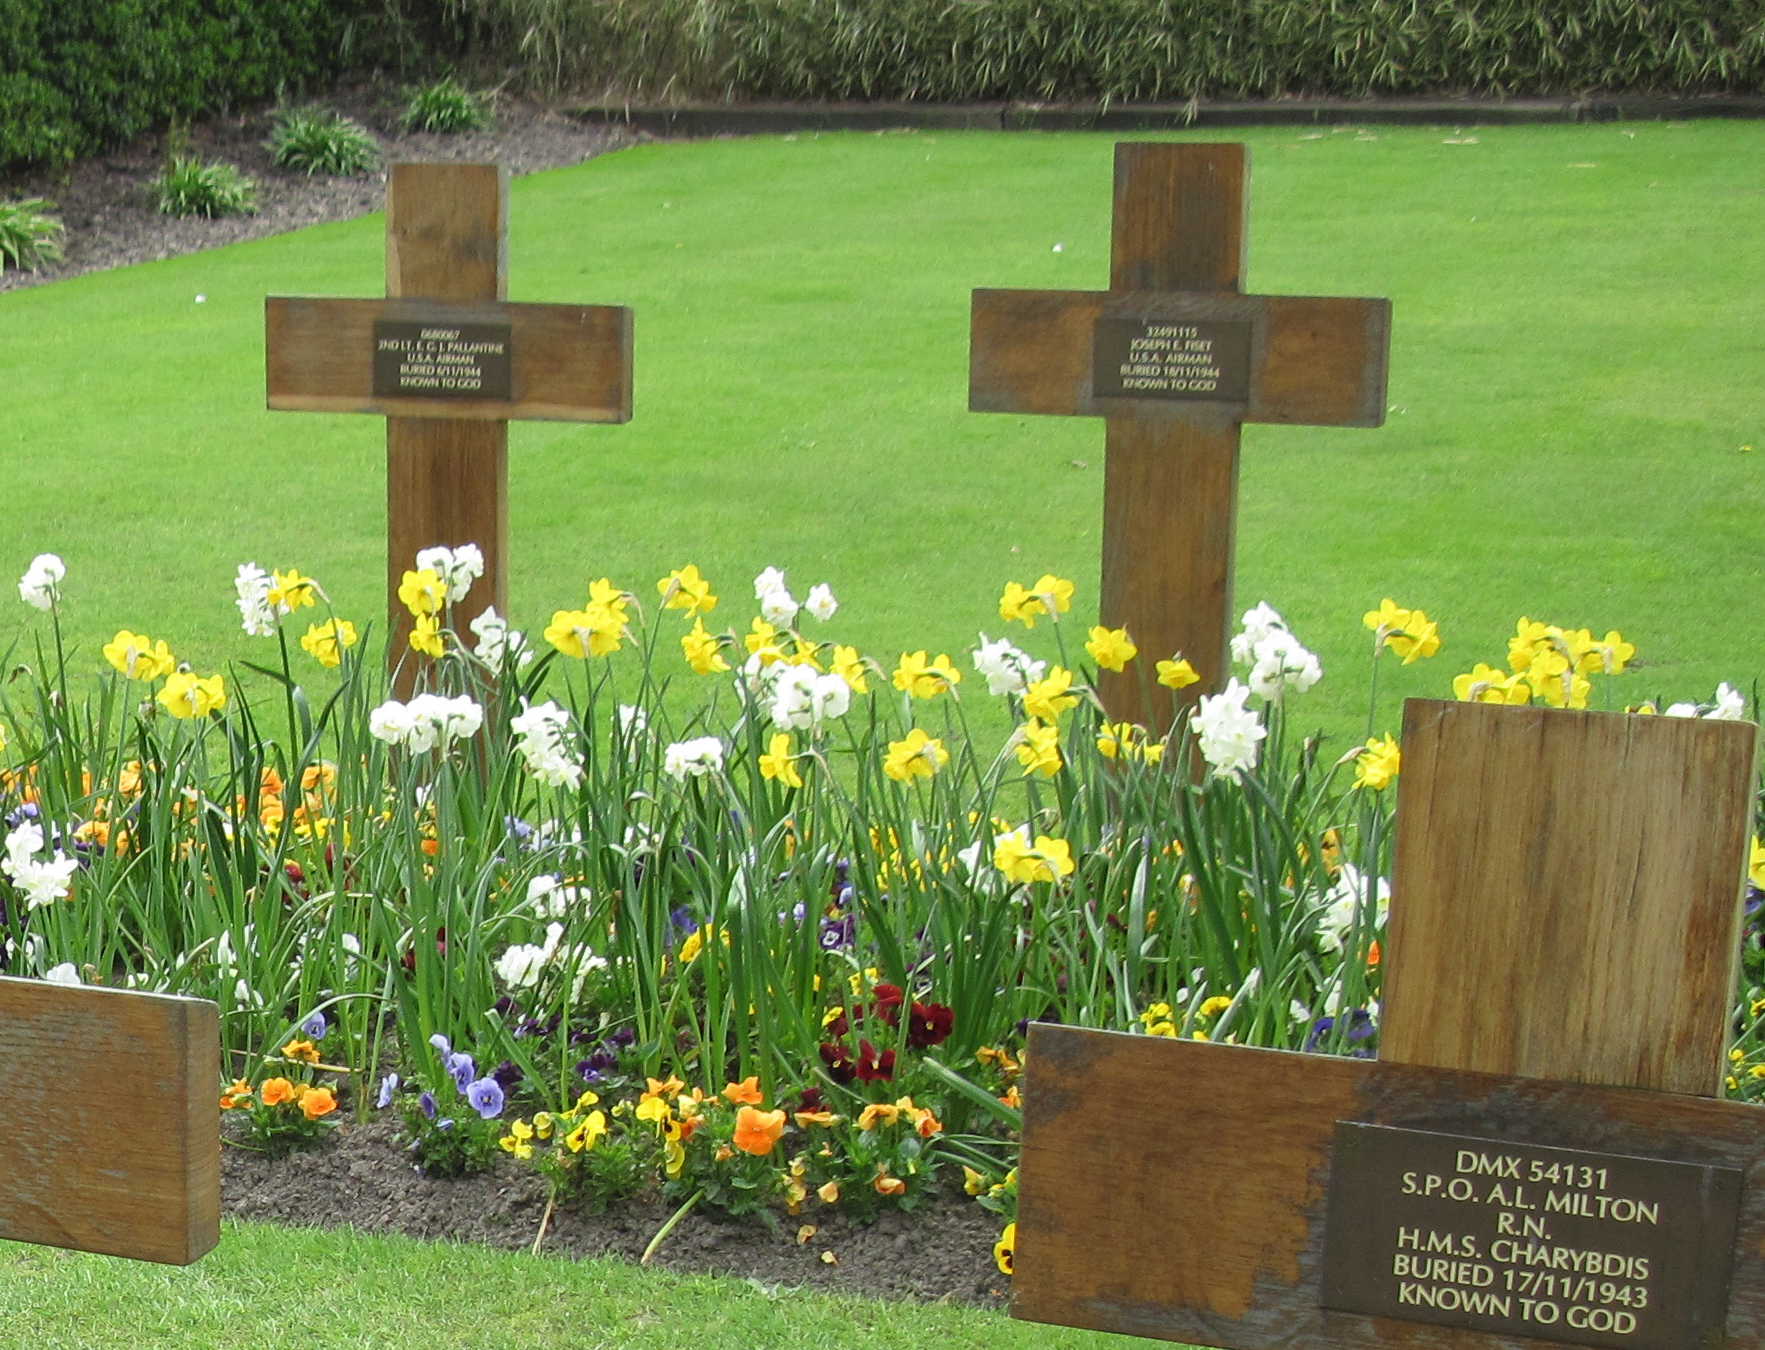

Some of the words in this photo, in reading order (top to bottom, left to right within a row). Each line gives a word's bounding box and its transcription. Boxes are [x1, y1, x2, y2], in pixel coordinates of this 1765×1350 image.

[378, 340, 399, 350] 2ND
[1130, 338, 1171, 350] JOSEPH
[436, 354, 475, 365] AIRMAN
[1130, 352, 1162, 363] U.S.A.
[1165, 353, 1212, 364] AIRMAN
[400, 365, 434, 375] BURIED
[437, 366, 481, 377] 6/11/1944
[1120, 364, 1161, 376] BURIED
[400, 377, 440, 388] KNOWN
[441, 378, 456, 389] TO
[457, 378, 482, 390] GOD
[1123, 377, 1168, 389] KNOWN
[1170, 378, 1187, 390] TO
[1189, 379, 1217, 392] GOD
[1456, 1150, 1521, 1180] DMX
[1528, 1161, 1608, 1190] 54131
[1401, 1172, 1479, 1203] S.P.O.
[1486, 1185, 1536, 1210] A.L.
[1544, 1191, 1658, 1226] MILTON
[1497, 1212, 1551, 1241] R.N.
[1398, 1226, 1481, 1259] H.M.S.
[1491, 1240, 1649, 1280] CHARYBDIS
[1394, 1254, 1494, 1288] BURIED
[1503, 1268, 1648, 1309] 17/11/1943
[1399, 1282, 1510, 1318] KNOWN
[1518, 1298, 1560, 1325] TO
[1566, 1305, 1636, 1335] GOD
